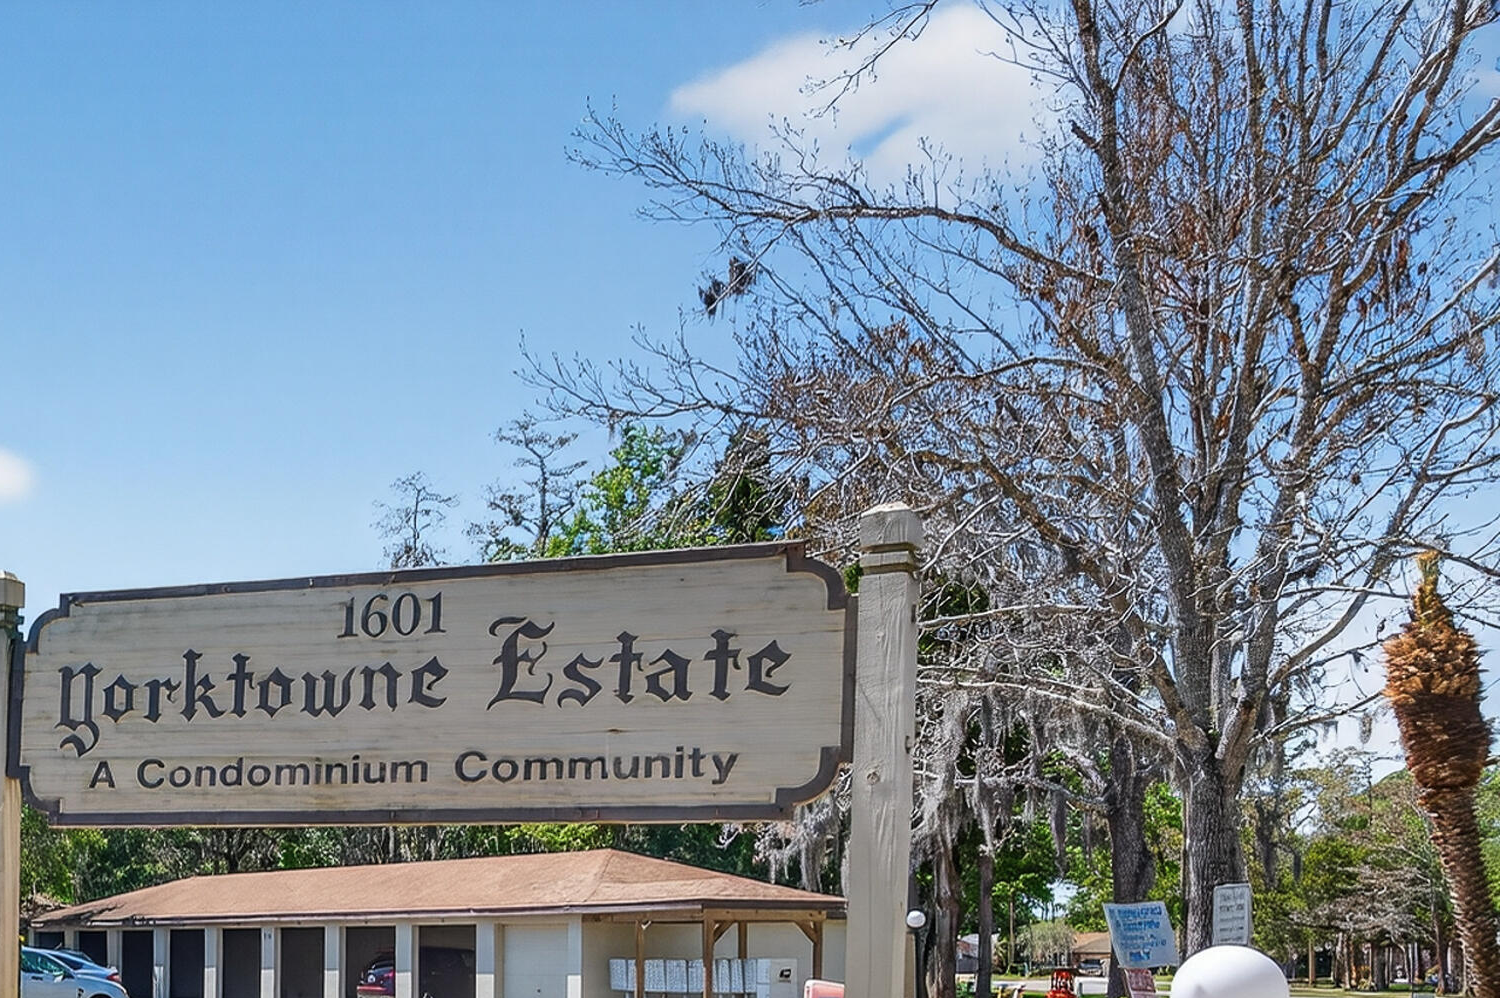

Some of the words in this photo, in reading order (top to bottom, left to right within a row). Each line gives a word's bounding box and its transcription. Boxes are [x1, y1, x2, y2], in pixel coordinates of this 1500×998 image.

[337, 591, 446, 639] 1601
[486, 616, 793, 711] Estate
[88, 760, 116, 789] A
[136, 753, 429, 789] Condominium
[453, 746, 740, 786] Community
